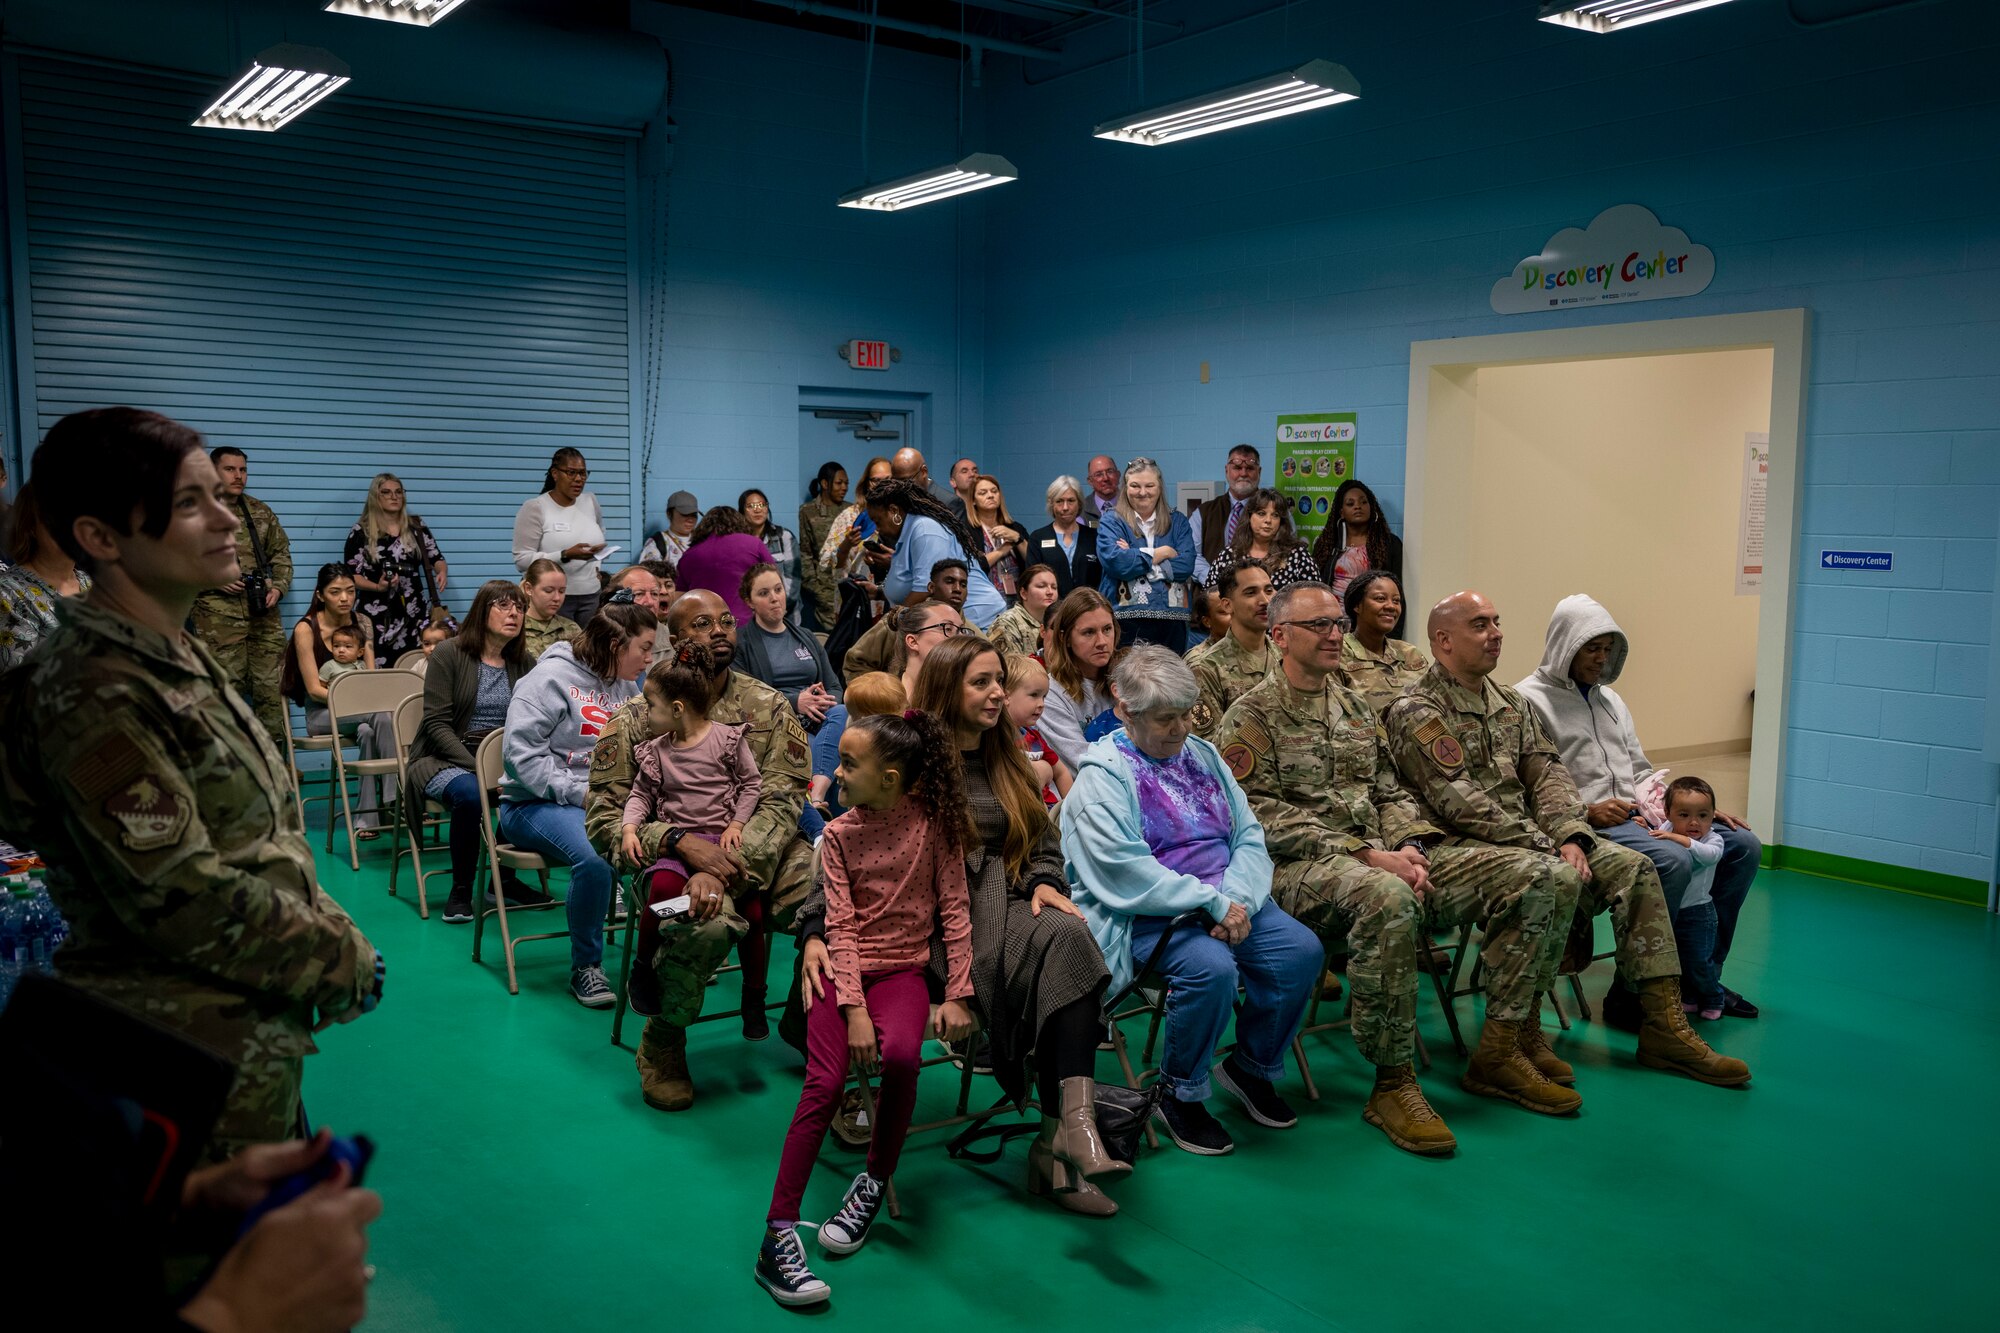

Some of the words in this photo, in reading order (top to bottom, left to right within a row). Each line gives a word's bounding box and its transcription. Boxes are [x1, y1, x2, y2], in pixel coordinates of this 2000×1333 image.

[1522, 263, 1615, 290] Discovery
[1621, 250, 1688, 283] Center
[857, 341, 885, 367] EXIT
[1285, 425, 1321, 441] Discovery
[1324, 425, 1349, 439] Center
[1834, 555, 1865, 566] Discovery
[1866, 556, 1889, 565] Center
[570, 686, 595, 703] Dust
